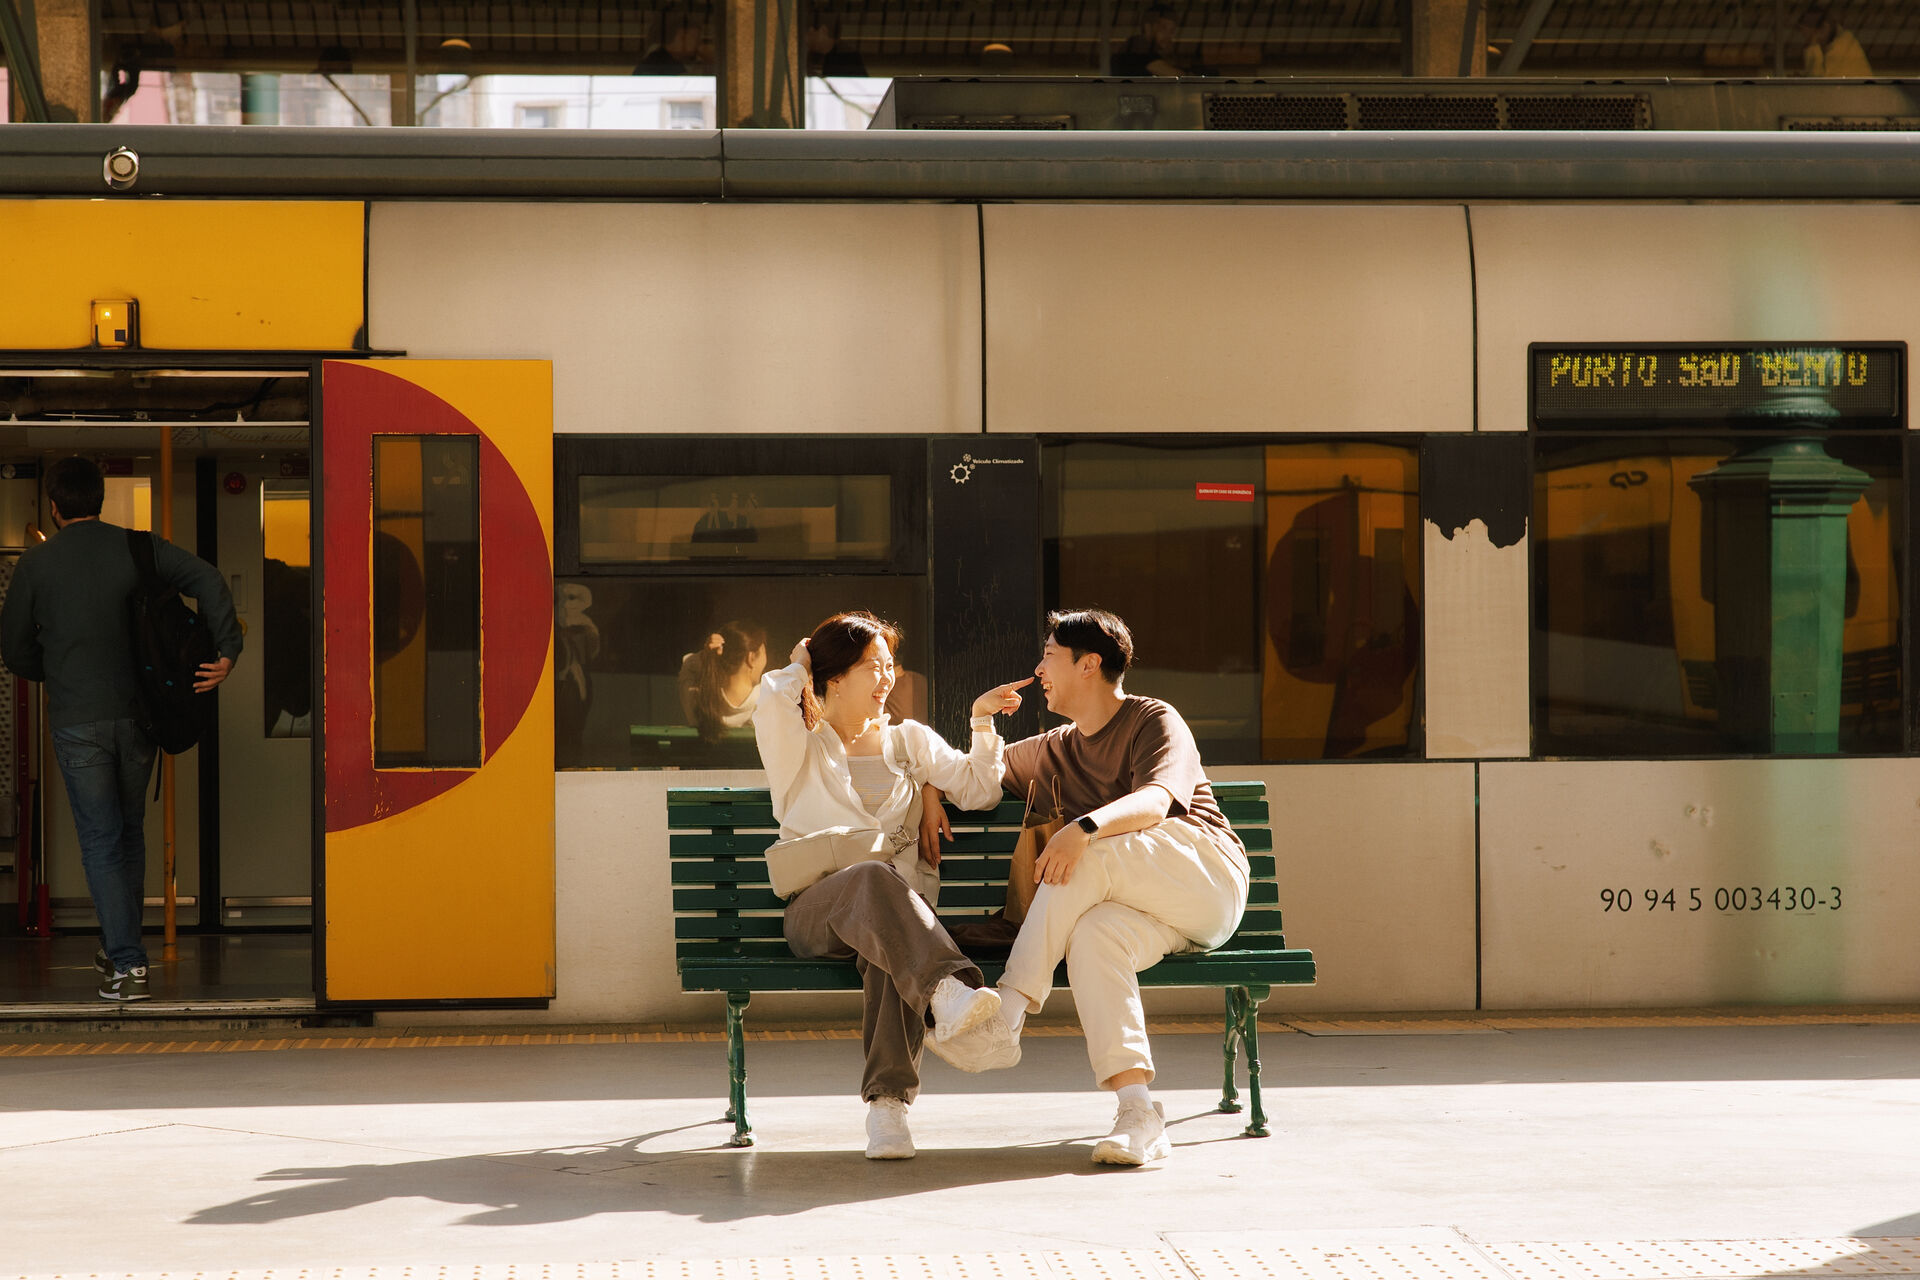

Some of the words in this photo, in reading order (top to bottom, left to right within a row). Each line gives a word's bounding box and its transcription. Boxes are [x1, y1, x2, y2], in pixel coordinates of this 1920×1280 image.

[1600, 888, 1633, 912] 90
[1644, 887, 1676, 912] 94
[1688, 887, 1702, 912] 5
[1714, 886, 1842, 911] 003430-3
